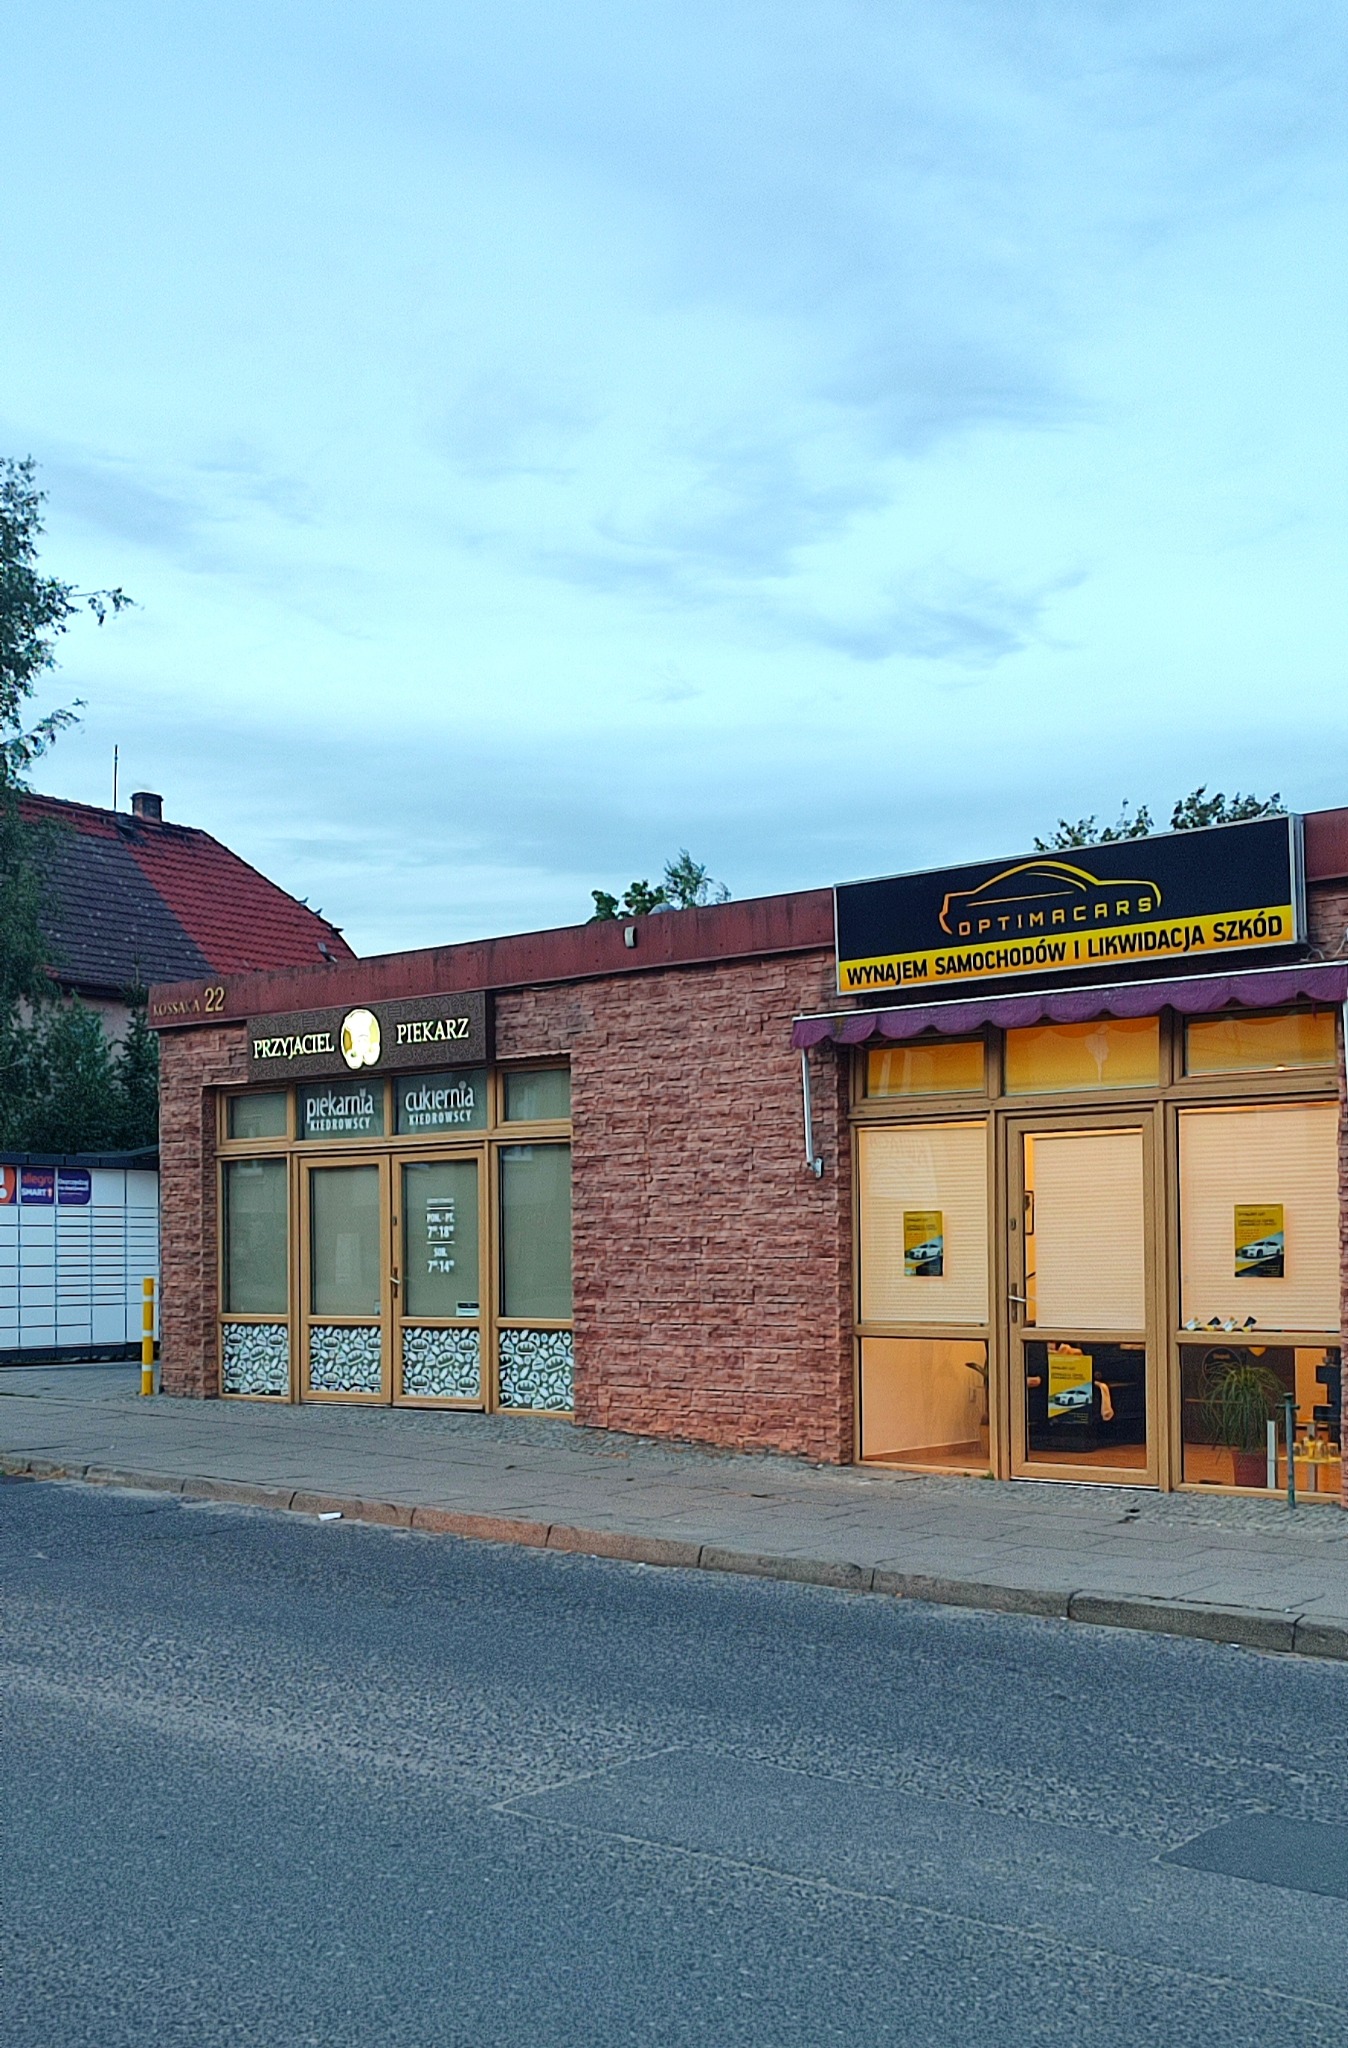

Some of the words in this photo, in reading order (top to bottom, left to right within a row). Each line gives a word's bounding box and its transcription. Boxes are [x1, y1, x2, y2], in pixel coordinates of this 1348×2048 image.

[958, 896, 1153, 936] OPTIMACARS
[846, 957, 928, 986] WYNAJEM
[934, 938, 1067, 976] SAMOCHODÓW
[1073, 940, 1080, 960] I
[1087, 926, 1206, 958] LIKWIDACJA
[1212, 911, 1284, 942] SZKÓD
[153, 998, 200, 1017] KOSSAKA
[204, 986, 225, 1013] 22
[252, 1032, 335, 1060] PRZYJACIEL
[395, 1018, 470, 1045] PIEKARZ
[306, 1088, 374, 1124] piekarnia
[405, 1081, 475, 1112] cukiernia
[310, 1117, 371, 1131] KIEDROWSCY
[409, 1110, 472, 1126] KIEDROWSCY
[22, 1173, 53, 1187] allegro
